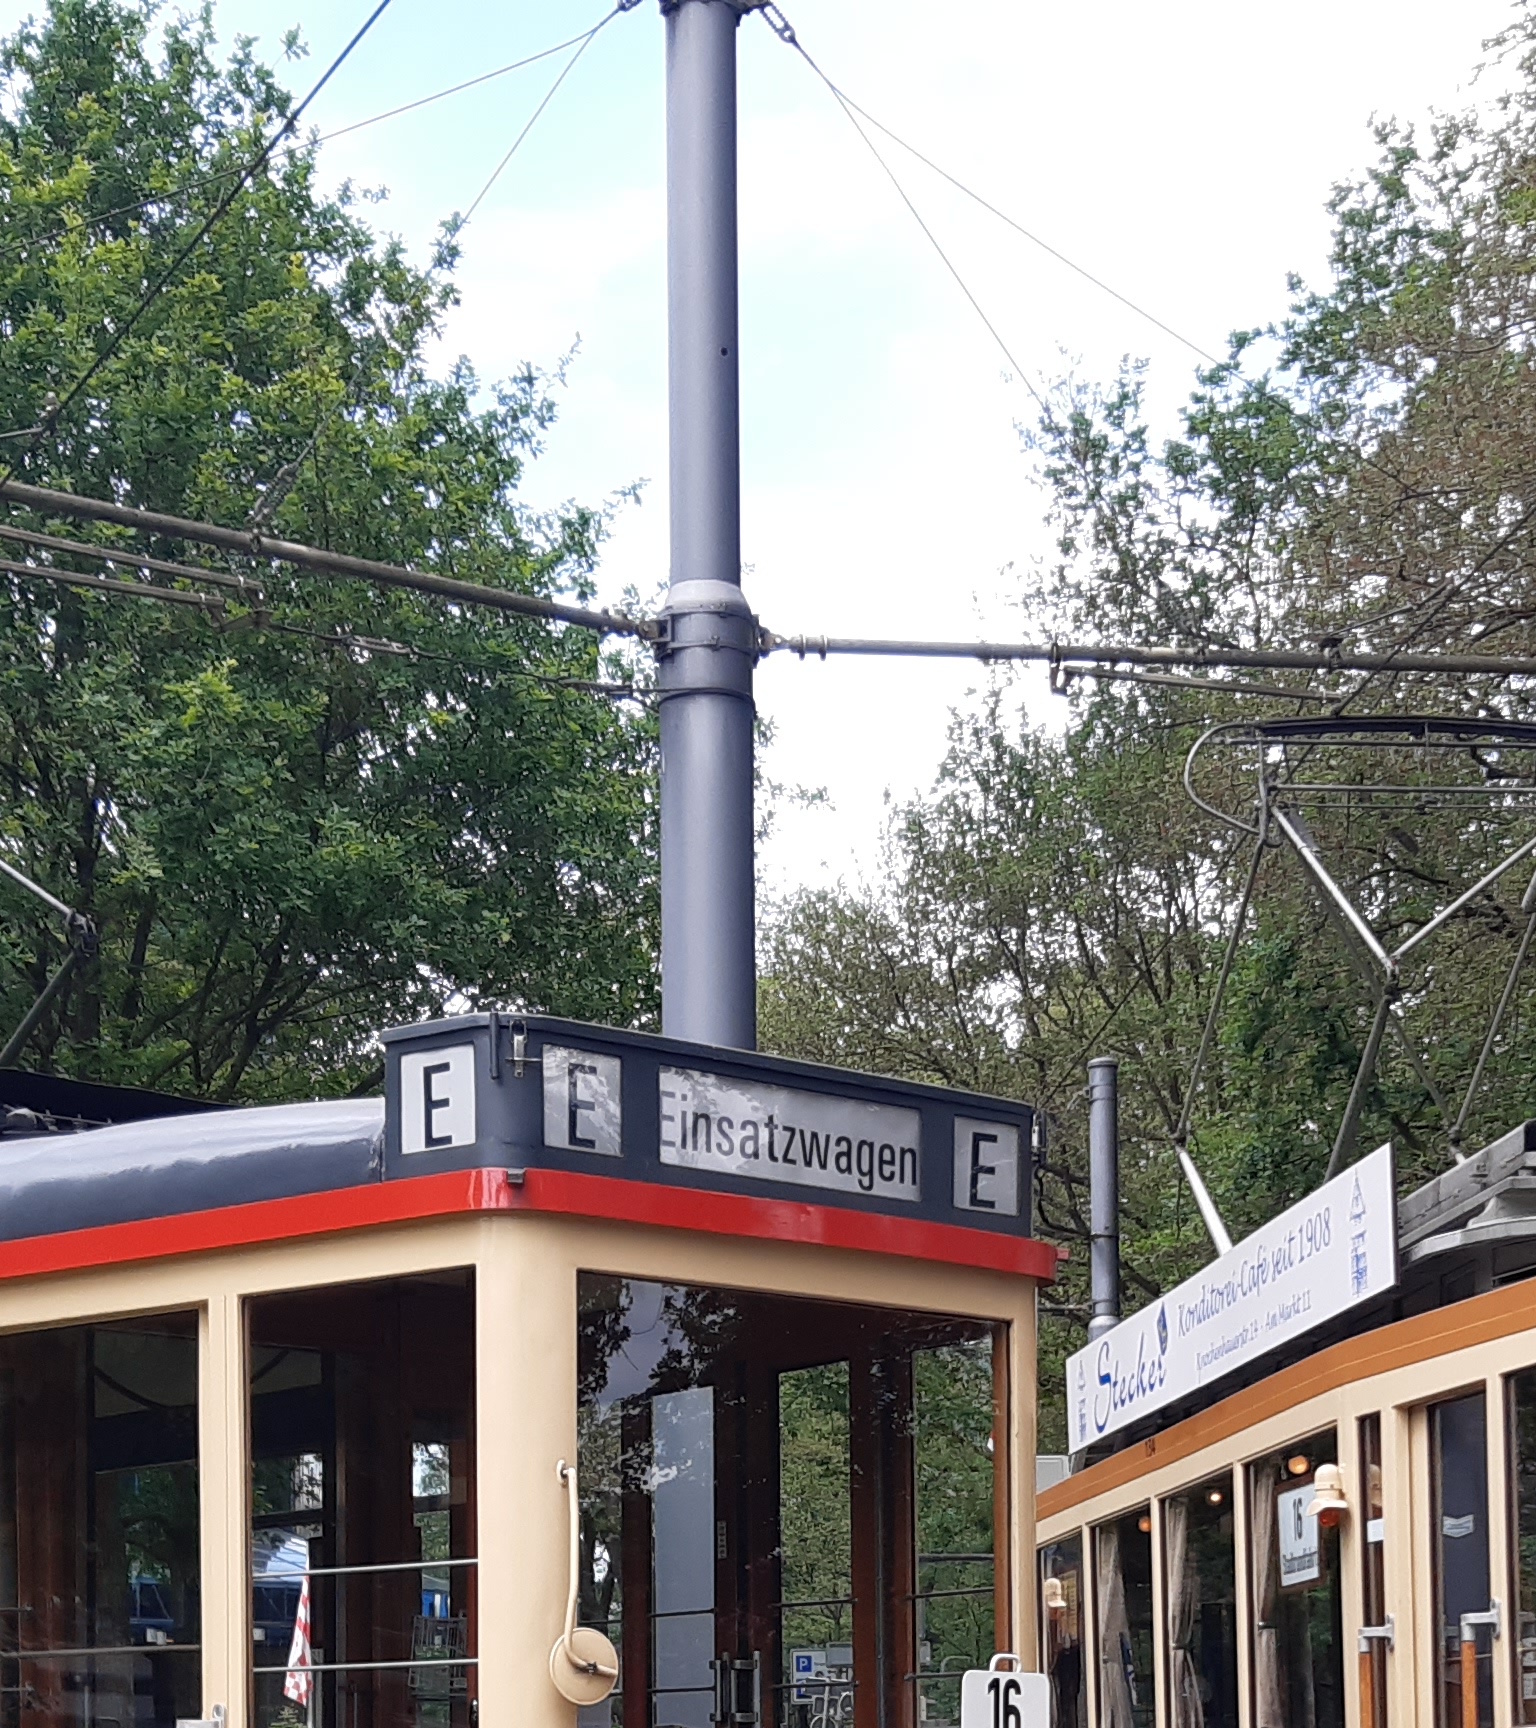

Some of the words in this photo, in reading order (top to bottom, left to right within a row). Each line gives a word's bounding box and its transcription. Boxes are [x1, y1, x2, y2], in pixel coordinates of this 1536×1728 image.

[423, 1061, 454, 1148] E
[567, 1062, 597, 1149] E
[660, 1089, 919, 1190] Einsatzwagen
[971, 1131, 998, 1209] E
[1177, 1244, 1268, 1338] Konditorei-Café
[1270, 1229, 1296, 1283] seit
[1297, 1206, 1331, 1264] 1908
[1292, 1496, 1303, 1542] 16
